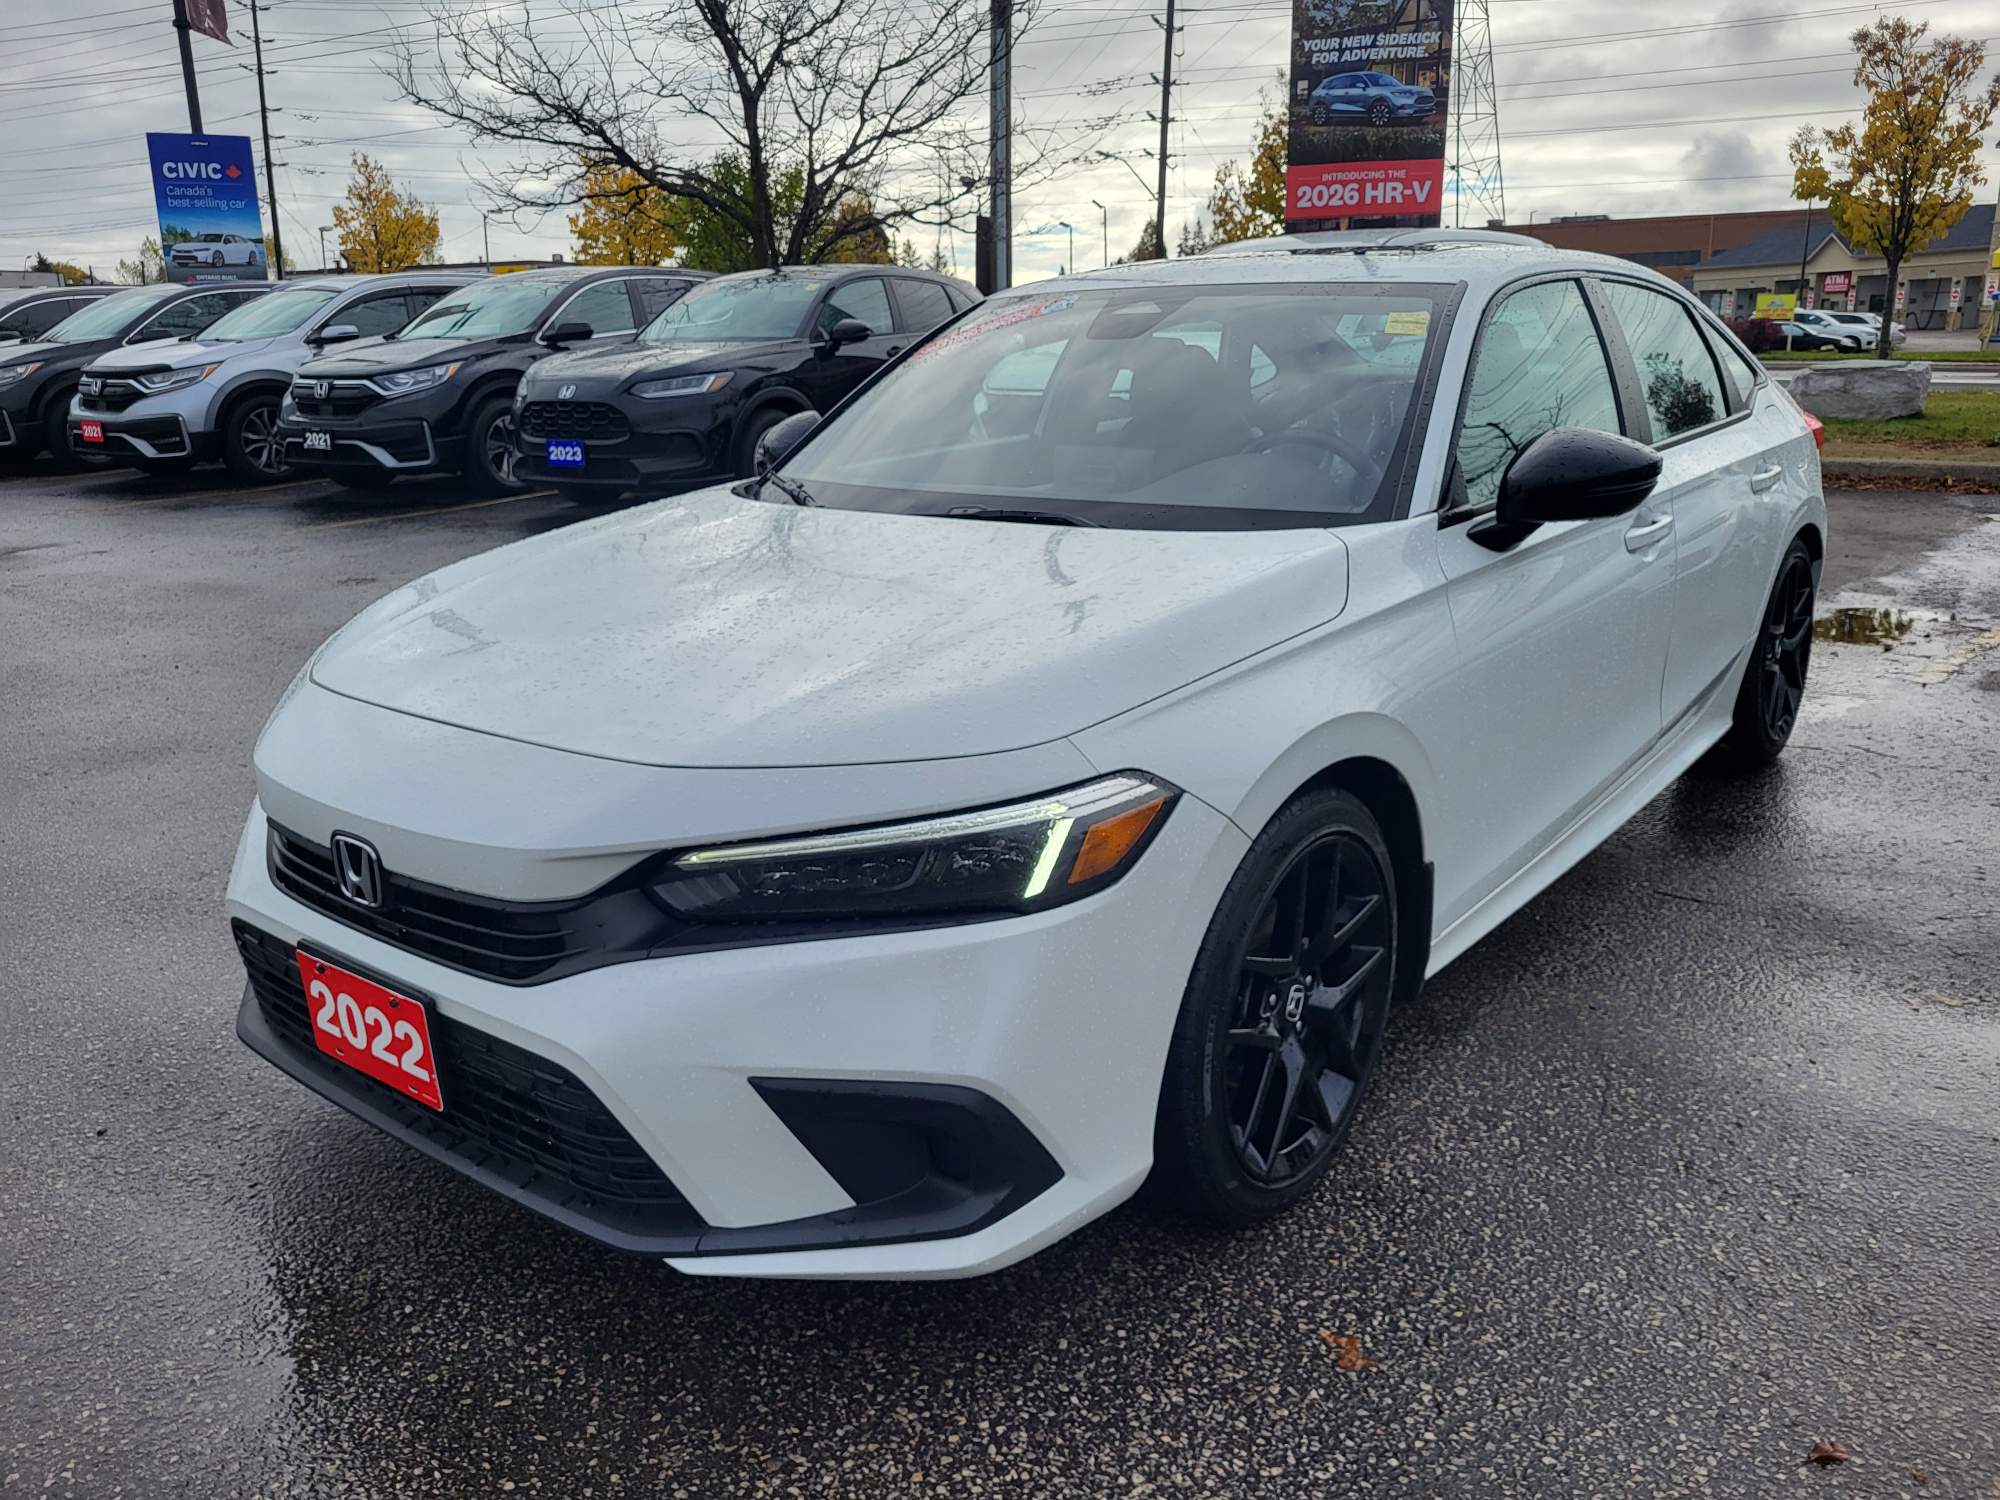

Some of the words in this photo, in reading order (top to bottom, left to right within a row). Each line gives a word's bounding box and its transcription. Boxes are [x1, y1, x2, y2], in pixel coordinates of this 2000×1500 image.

[1303, 36, 1344, 52] YOUR
[1342, 34, 1374, 48] NEW
[1376, 31, 1441, 45] SIDEKICK
[1311, 51, 1341, 65] FOR
[1341, 46, 1429, 62] ADVENTURE.
[162, 161, 223, 179] CIVIC
[1322, 171, 1385, 182] INTRODUCING
[1388, 170, 1407, 179] THE
[166, 185, 213, 196] Canada's
[1296, 183, 1360, 208] 2026
[1364, 180, 1432, 205] HR-V
[168, 197, 227, 210] best-selling
[229, 200, 246, 209] car
[1824, 274, 1845, 285] ATM
[82, 425, 102, 437] 2021
[304, 431, 331, 448] 2021
[549, 446, 582, 461] 2023
[310, 979, 431, 1083] 2022
